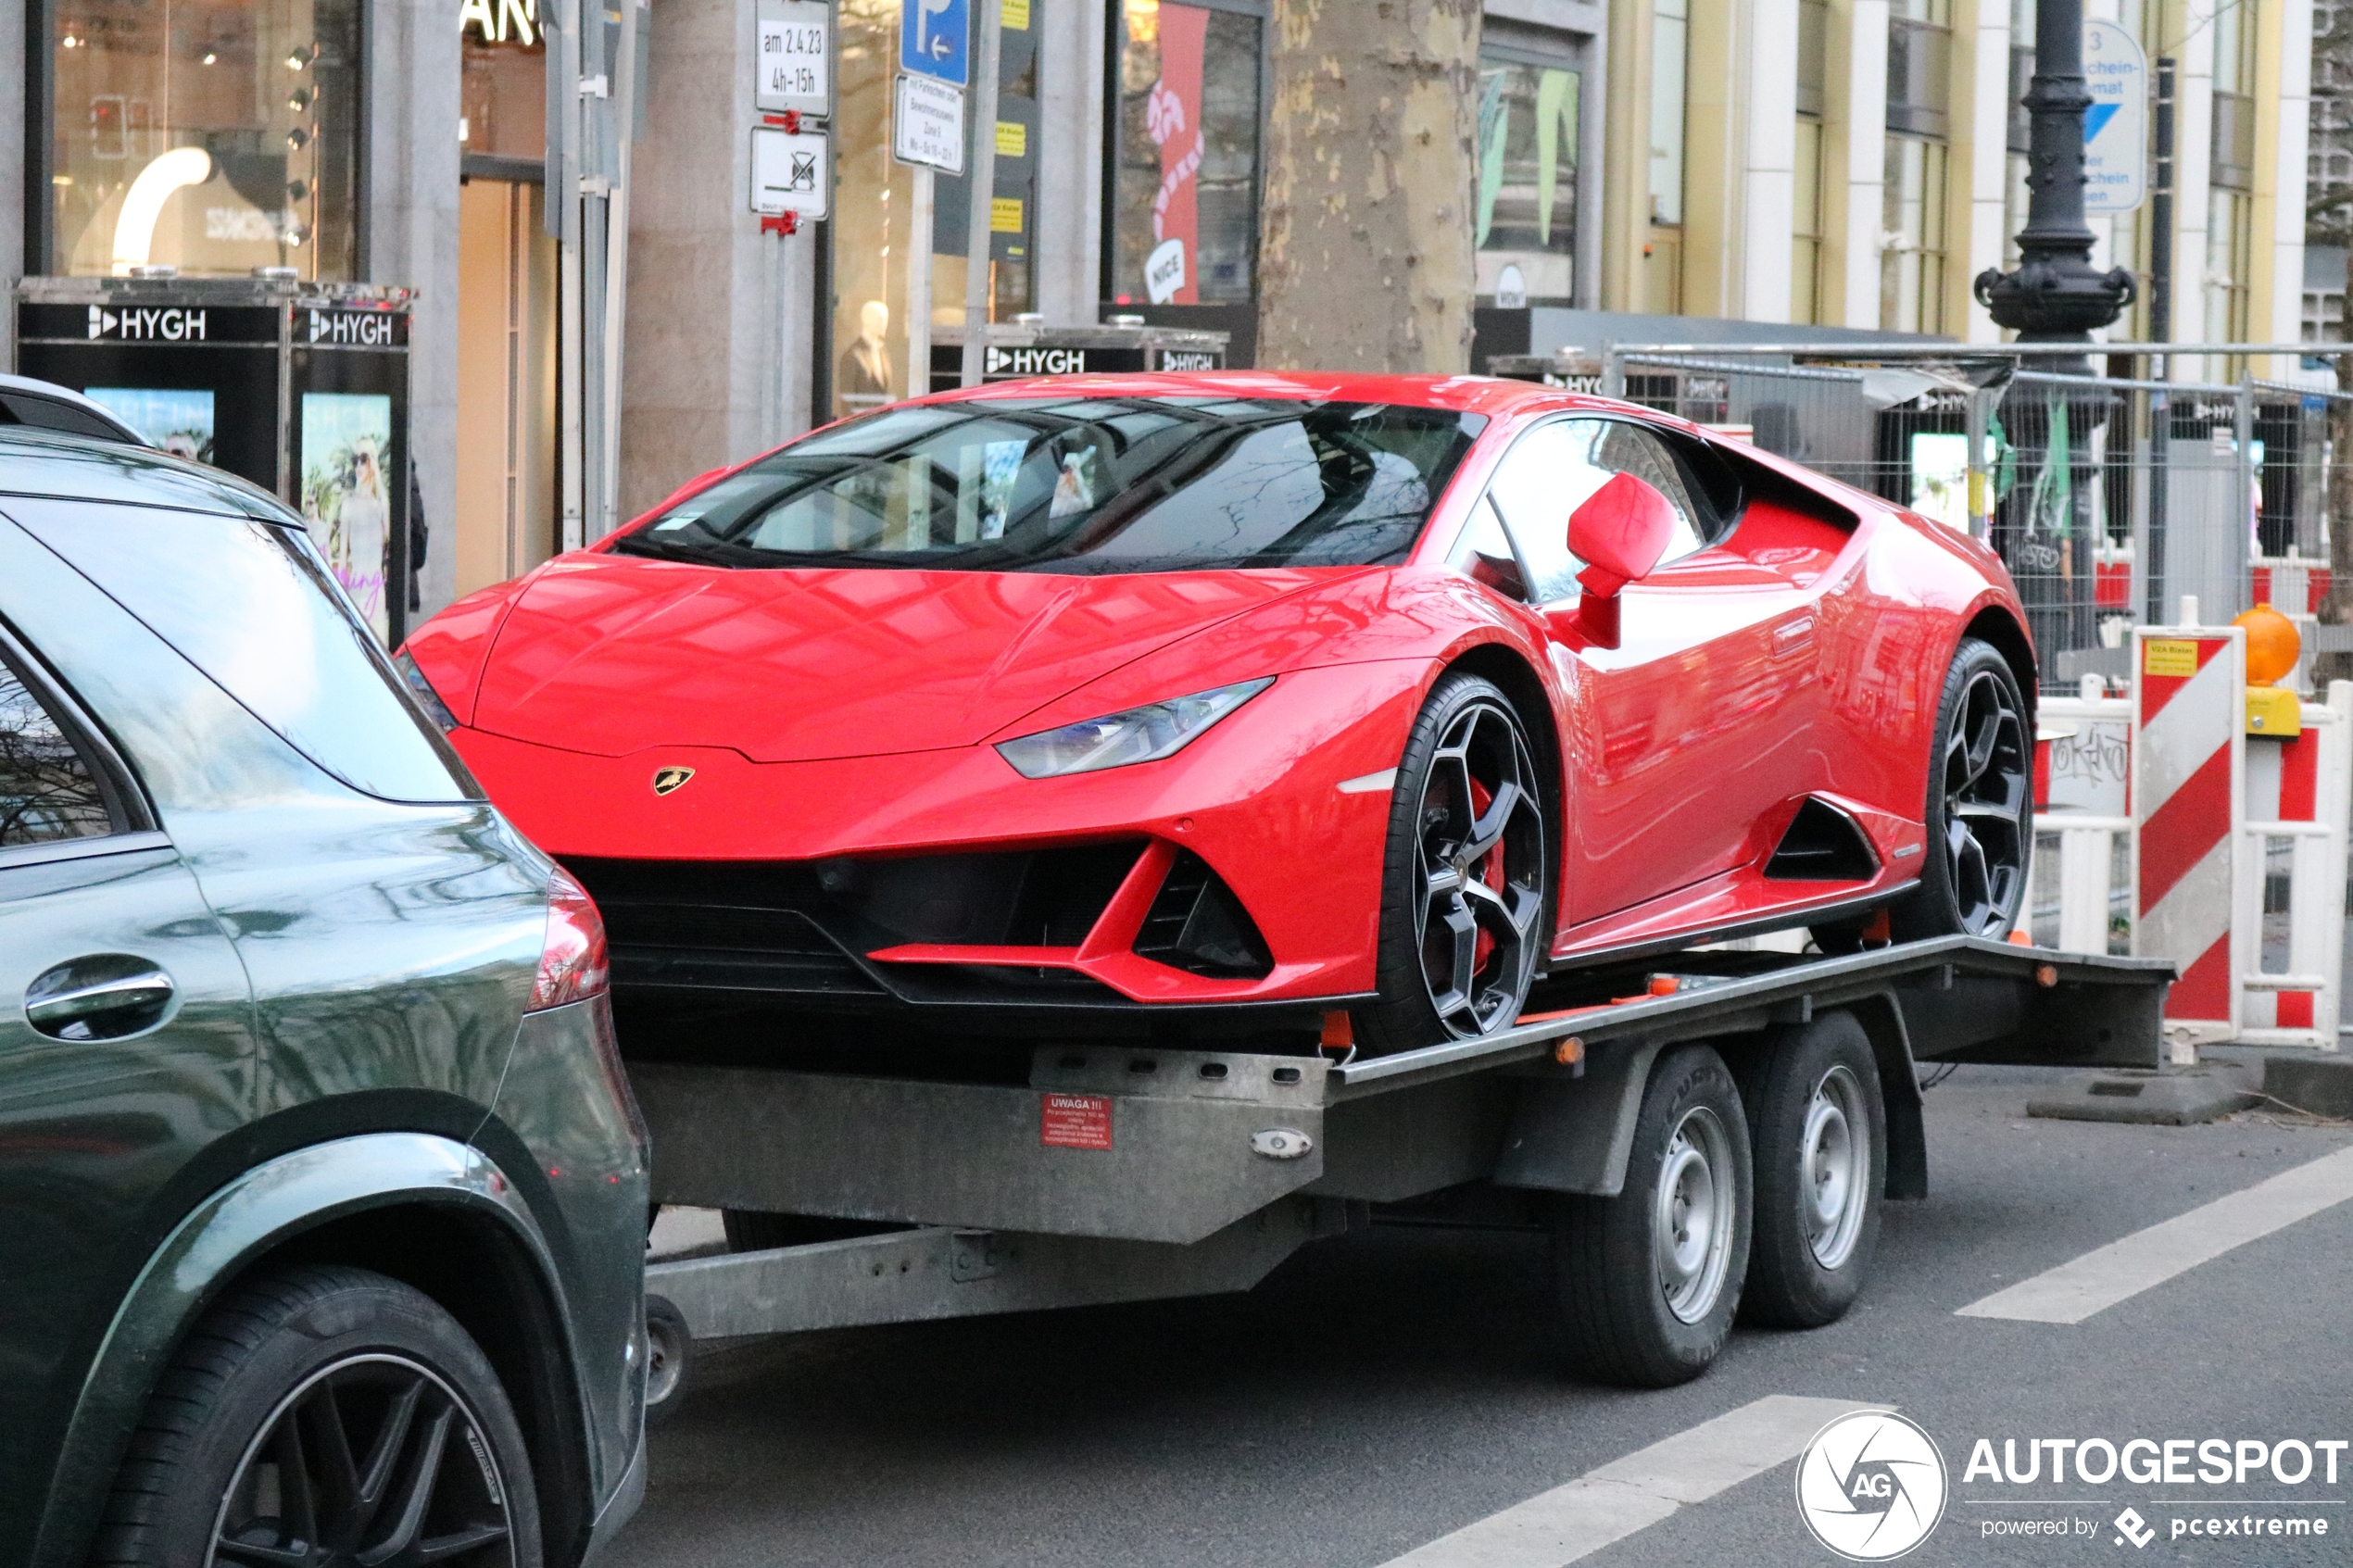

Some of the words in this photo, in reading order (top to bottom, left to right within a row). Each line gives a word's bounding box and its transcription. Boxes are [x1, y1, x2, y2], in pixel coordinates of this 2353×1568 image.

[764, 34, 782, 53] am
[786, 29, 823, 55] 2.4.23
[1152, 254, 1180, 289] NICE
[120, 307, 207, 341] HYGH
[332, 313, 392, 345] HYGH
[1014, 349, 1085, 374] HYGH
[1051, 1098, 1089, 1110] UWAGA
